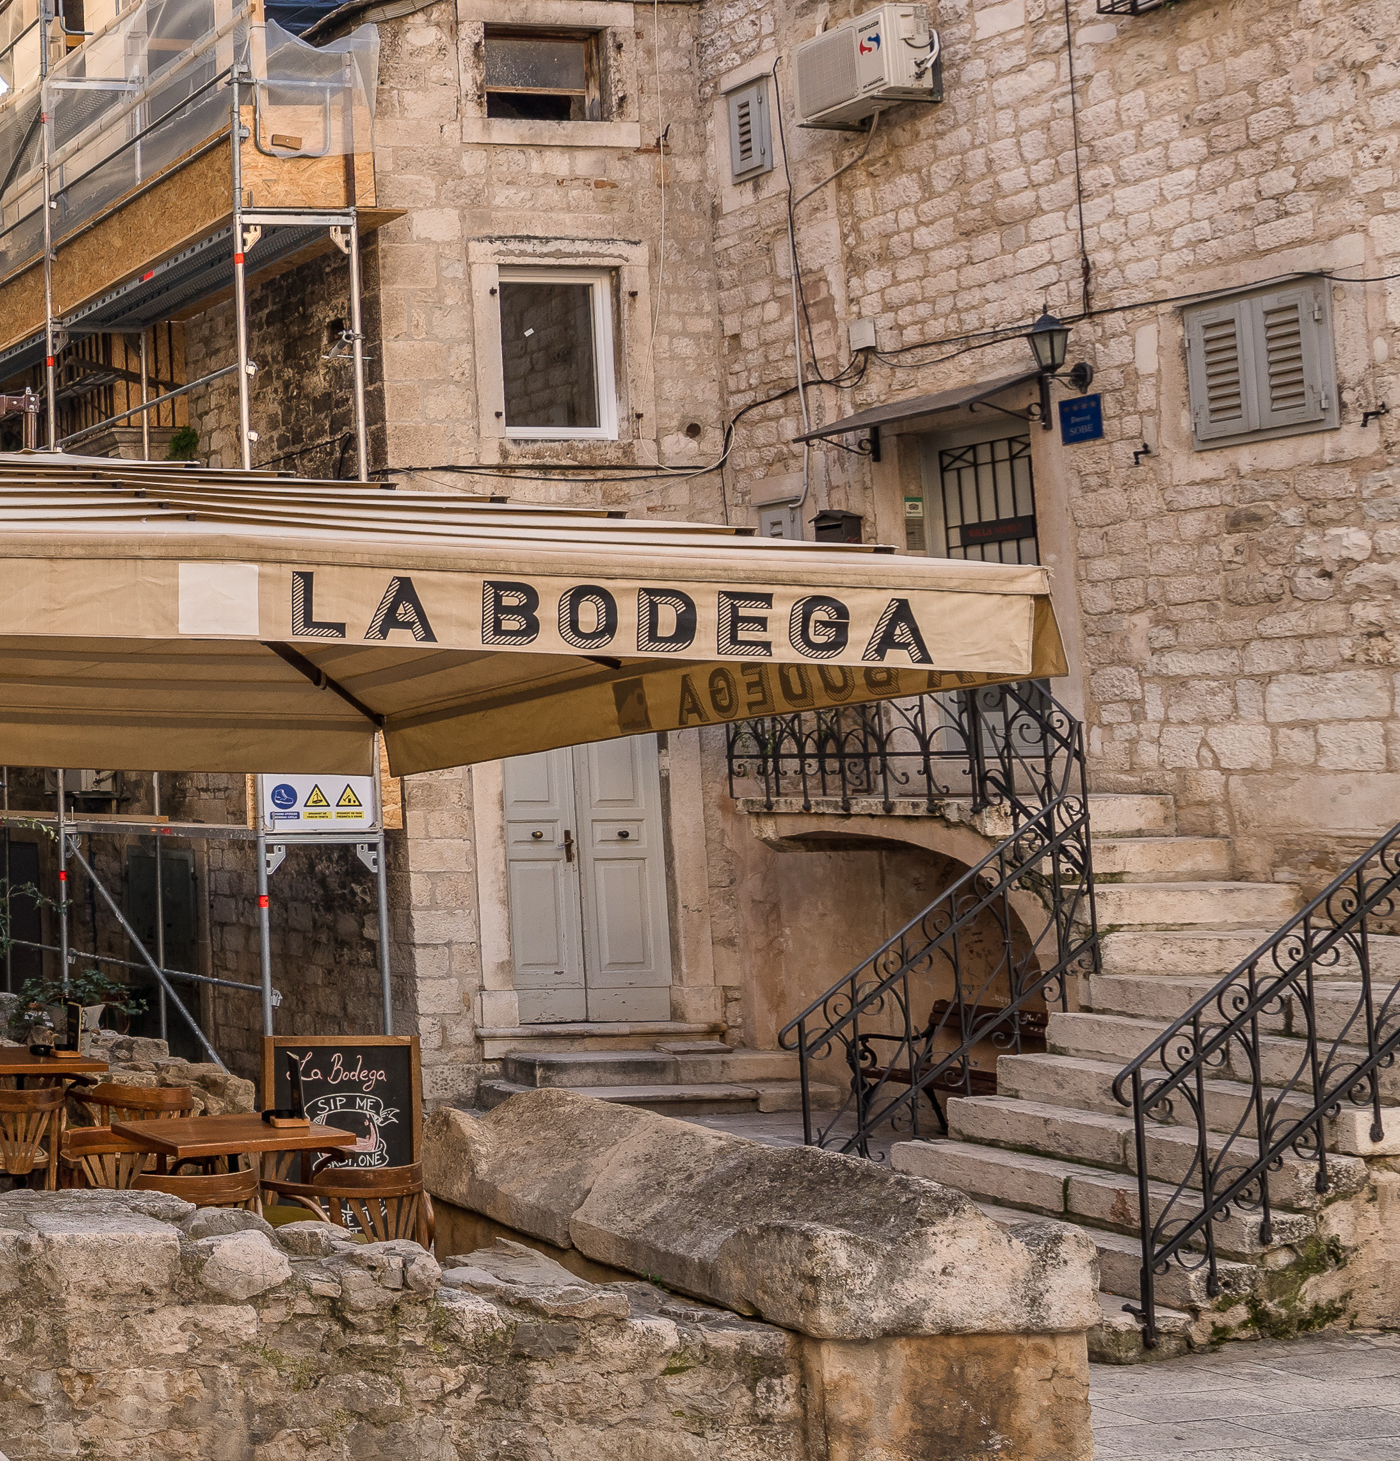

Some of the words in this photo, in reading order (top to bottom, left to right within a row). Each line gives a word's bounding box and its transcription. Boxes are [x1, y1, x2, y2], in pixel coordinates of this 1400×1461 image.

[1070, 424, 1093, 436] SOBE
[291, 570, 438, 643] LA
[481, 580, 934, 664] BODEGA
[286, 1051, 323, 1081] La
[327, 1052, 387, 1092] Bodega
[316, 1097, 347, 1114] SIP
[355, 1096, 377, 1113] ME
[358, 1151, 382, 1166] ONE
